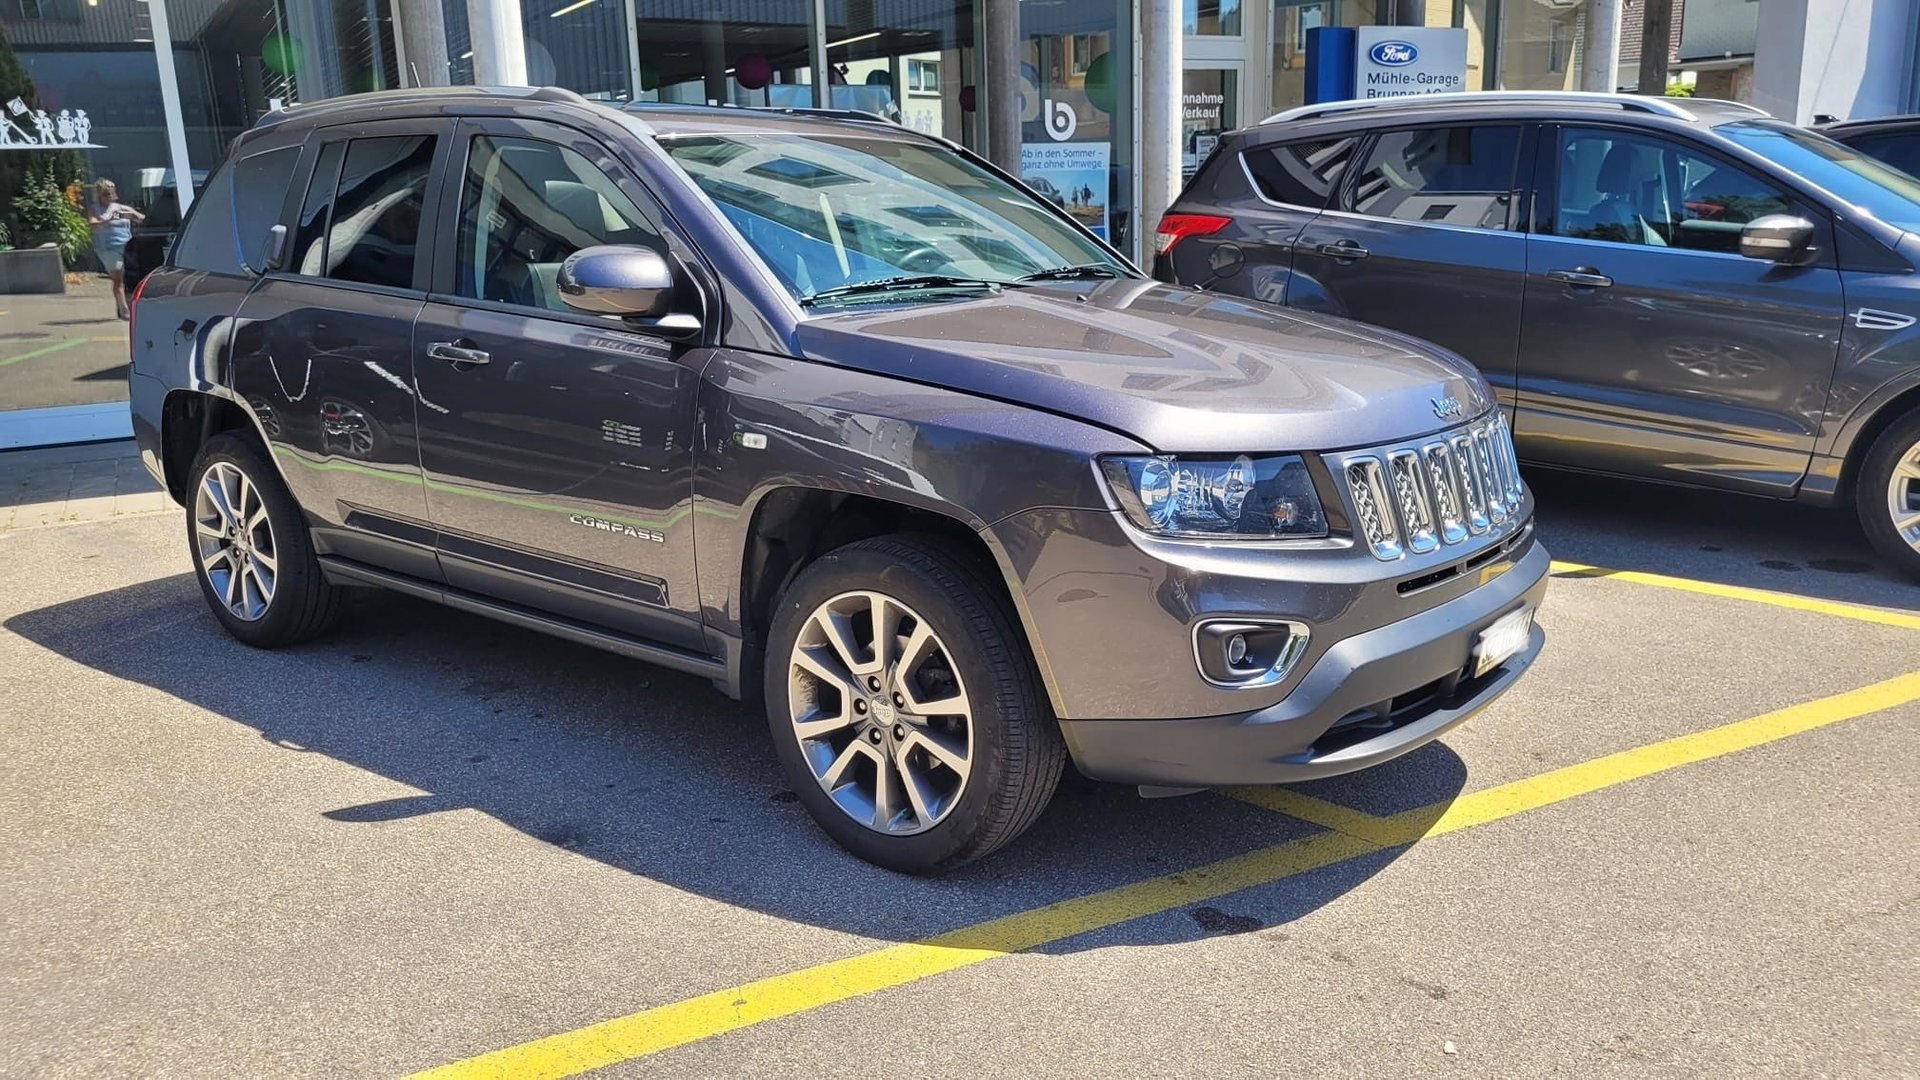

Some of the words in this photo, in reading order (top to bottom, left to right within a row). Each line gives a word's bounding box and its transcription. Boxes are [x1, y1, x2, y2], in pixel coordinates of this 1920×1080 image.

[1381, 44, 1412, 62] Ford
[1367, 72, 1459, 87] Mühle-Garage
[1182, 91, 1224, 104] nnahme
[1022, 149, 1033, 158] Ab
[1035, 149, 1043, 158] in
[1045, 149, 1061, 158] den
[1063, 148, 1096, 158] Sommer
[1022, 161, 1042, 170] ganz
[1044, 160, 1065, 168] ohne
[1067, 160, 1102, 170] Umwege
[1430, 397, 1462, 418] Jeep
[569, 513, 665, 543] COMPASS
